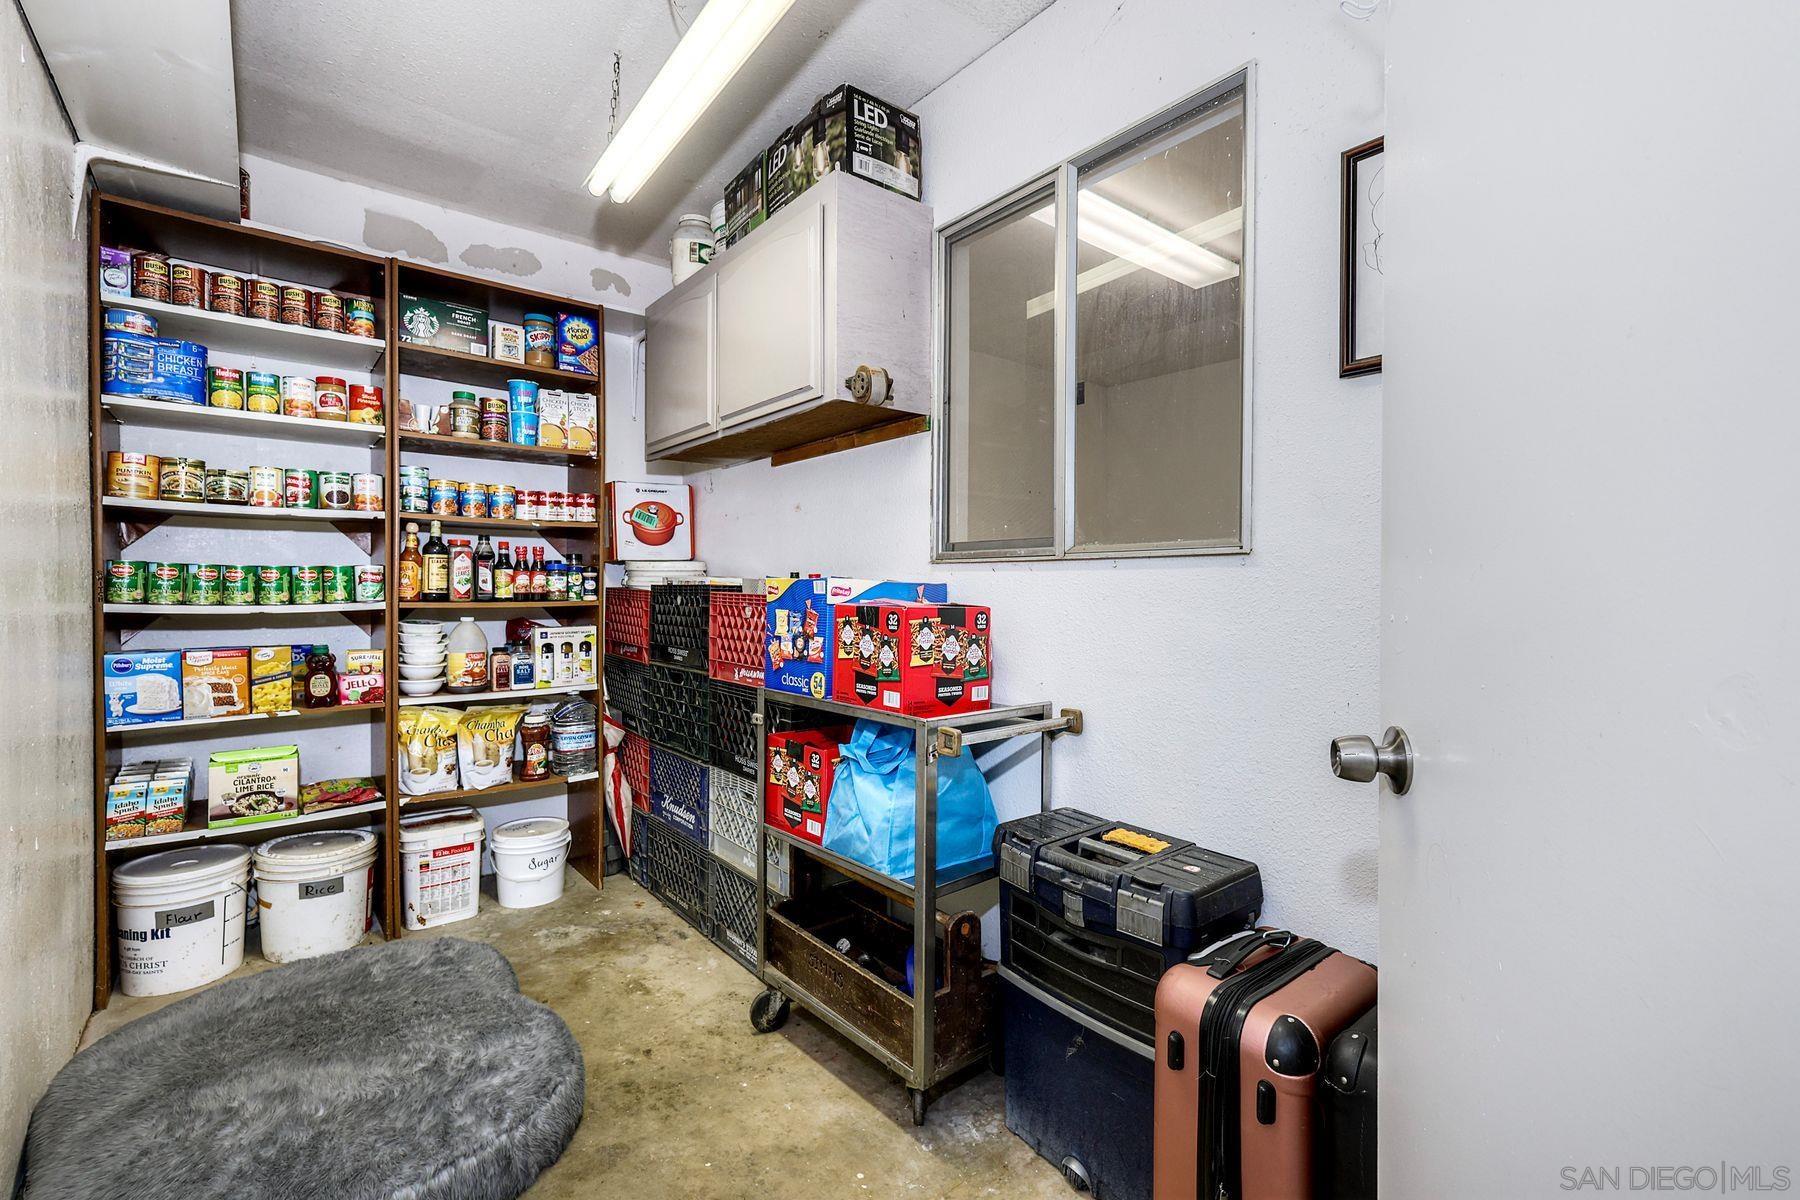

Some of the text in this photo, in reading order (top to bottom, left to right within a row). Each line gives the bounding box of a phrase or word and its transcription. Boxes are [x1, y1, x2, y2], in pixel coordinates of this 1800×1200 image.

[853, 98, 888, 129] LED
[854, 119, 880, 133] String Lights
[768, 144, 788, 180] LED
[145, 262, 168, 274] BUSH'S
[144, 272, 168, 282] Original
[219, 278, 240, 288] BUSH'S
[218, 287, 241, 296] Original
[285, 292, 306, 300] BUSH'S
[258, 294, 278, 302] Original
[284, 299, 306, 307] Original
[452, 313, 476, 322] FRENCH
[401, 334, 412, 343] 72
[530, 332, 551, 342] SKIPPY
[158, 354, 202, 368] CHICKEN
[158, 362, 199, 377] BREAST
[216, 369, 240, 379] Hudson
[252, 374, 274, 384] Hudson
[357, 398, 381, 406] Pineapple
[542, 397, 568, 406] CHICKEN
[544, 402, 564, 410] STOCK
[116, 468, 152, 476] PUMPKIN
[888, 614, 898, 626] 32
[977, 614, 987, 625] 32
[142, 656, 166, 665] Moist
[465, 659, 485, 669] Syrup
[135, 662, 173, 671] Supreme
[781, 672, 810, 688] classic
[813, 676, 823, 690] 54
[856, 682, 877, 691] SEASONED
[466, 718, 506, 730] Chamba
[406, 724, 450, 736] Chamba
[734, 754, 758, 771] ROSS SWIS
[811, 753, 820, 764] 32
[232, 776, 272, 787] CILANTRO
[235, 782, 275, 794] LIME RICE
[114, 800, 140, 810] Idaho
[154, 796, 178, 806] Idaho
[114, 806, 140, 816] Spuds
[153, 802, 178, 811] Spuds
[661, 793, 696, 825] Knudsen
[528, 854, 561, 871] Sugar
[304, 884, 335, 896] Rice
[166, 912, 203, 926] Flour
[150, 928, 172, 941] Kit
[129, 960, 168, 970] CHRIST
